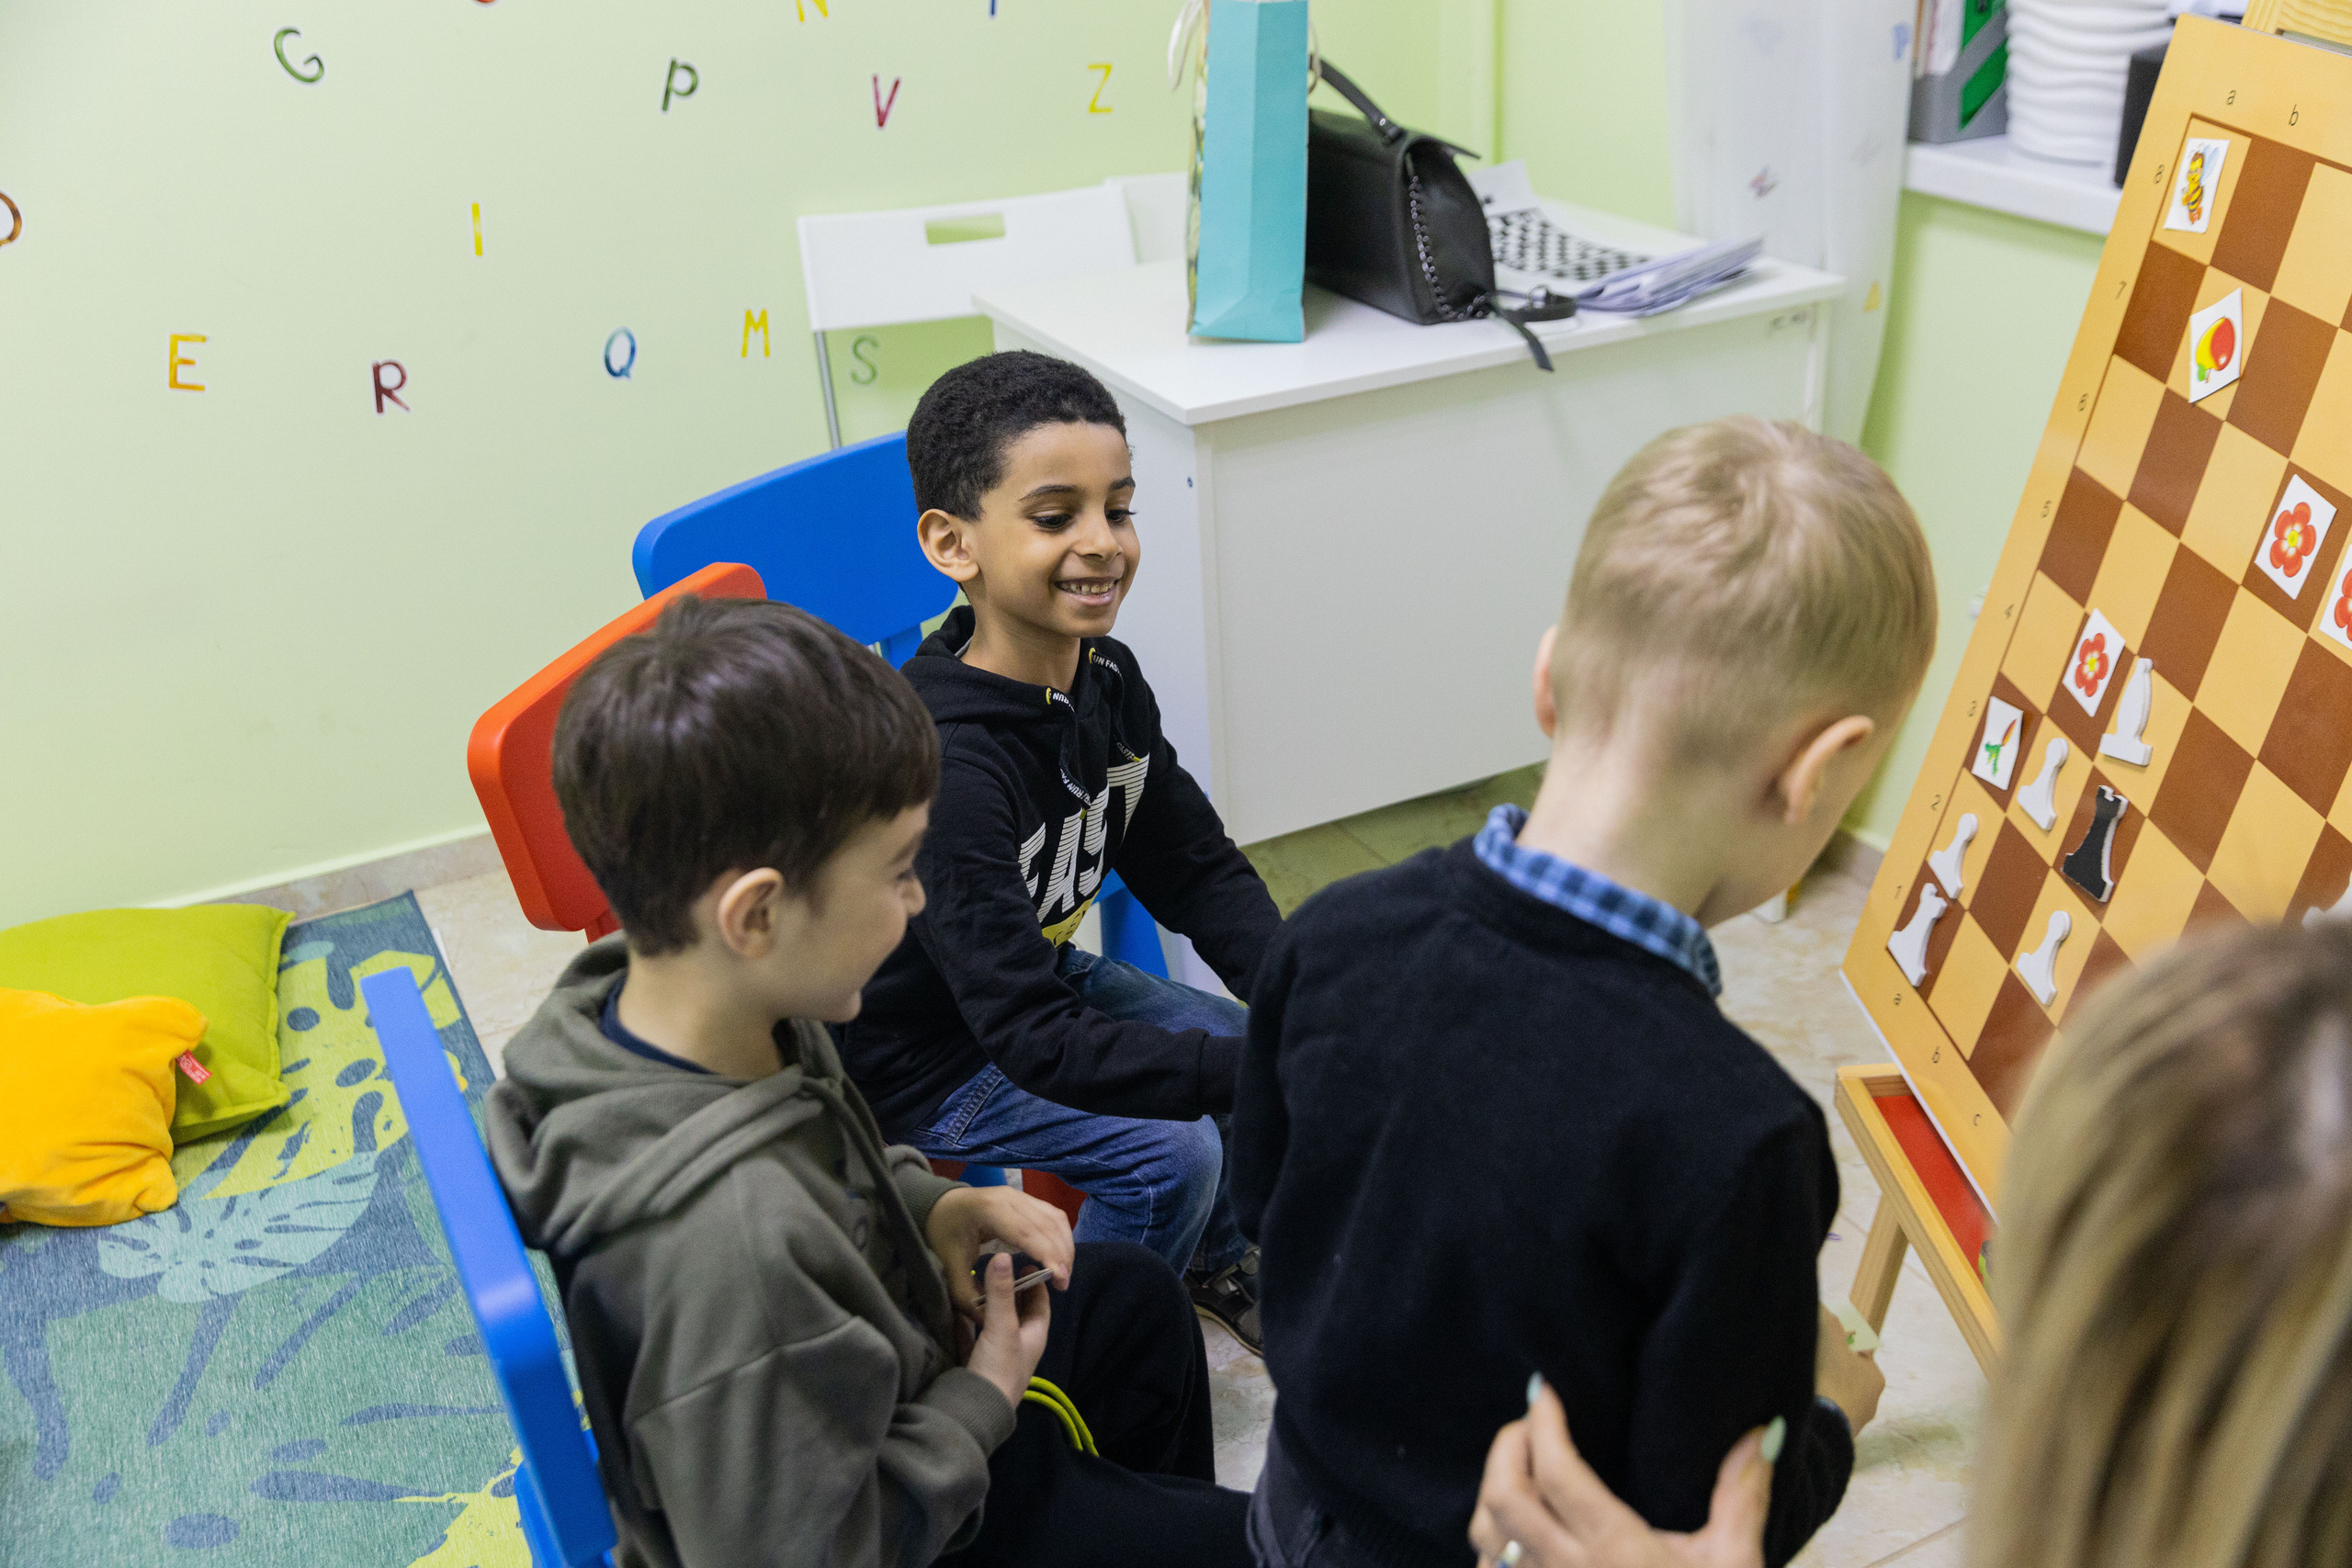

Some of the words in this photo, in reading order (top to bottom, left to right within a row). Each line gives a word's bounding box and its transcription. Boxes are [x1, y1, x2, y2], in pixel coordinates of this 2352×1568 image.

[273, 28, 324, 84] G
[662, 59, 698, 111] P
[872, 74, 900, 128] V
[1088, 63, 1113, 113] Z
[2226, 89, 2237, 106] a
[2289, 103, 2300, 127] b
[2153, 164, 2165, 185] 8
[2115, 280, 2127, 300] 7
[604, 326, 637, 379] Q
[741, 309, 771, 357] M
[168, 333, 207, 391] E
[851, 335, 879, 384] S
[372, 360, 410, 413] R
[1930, 794, 1942, 812] 2
